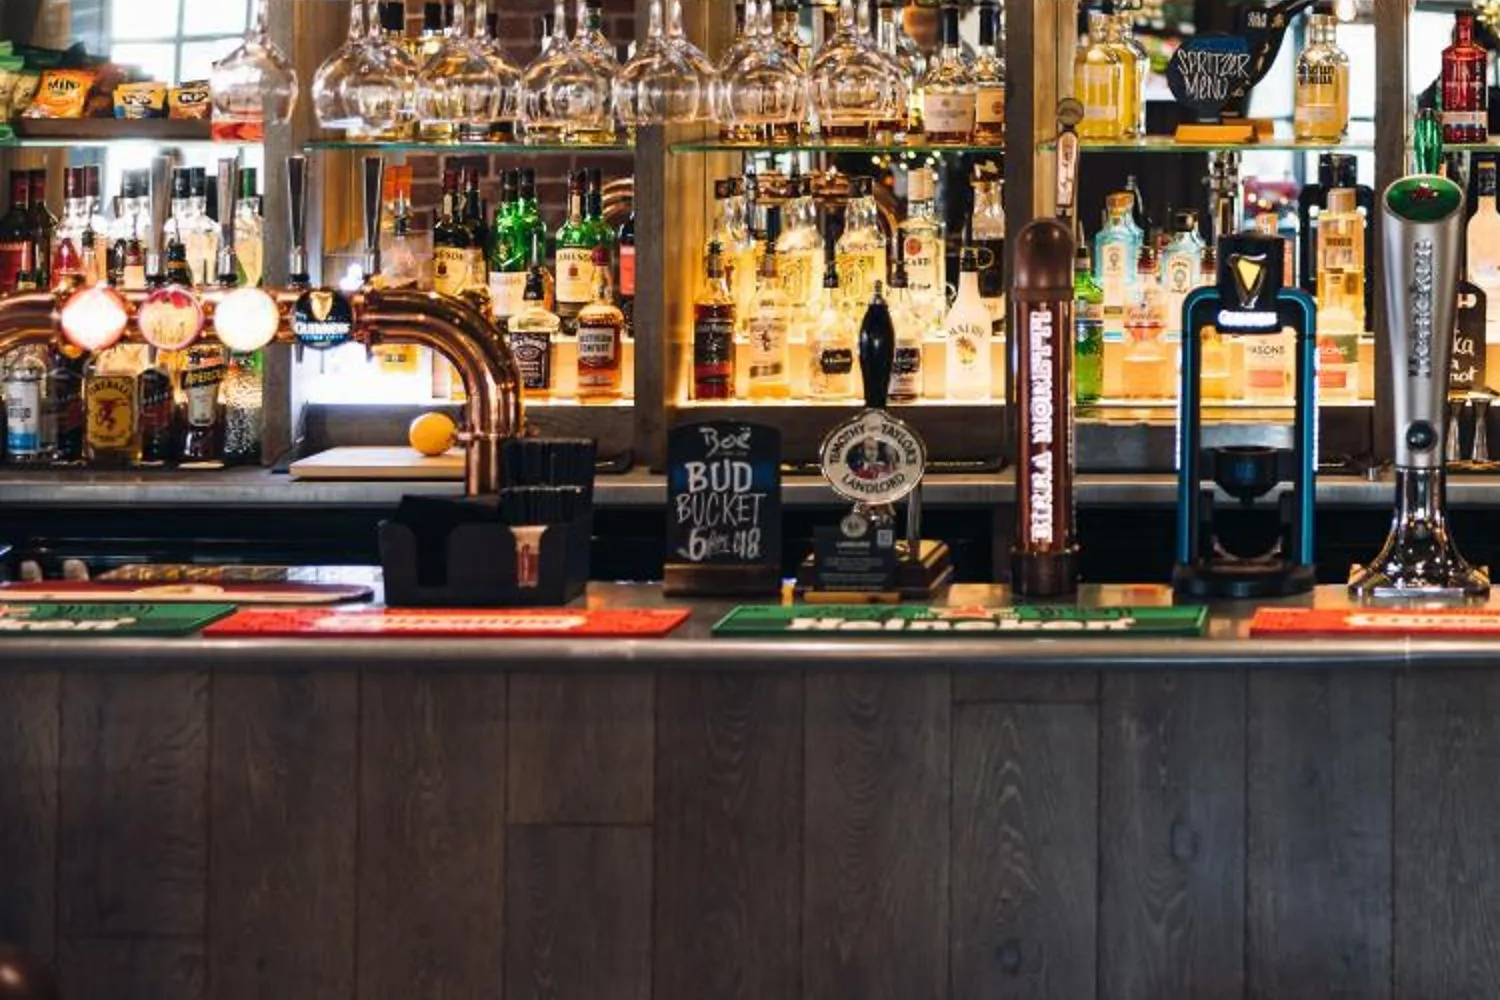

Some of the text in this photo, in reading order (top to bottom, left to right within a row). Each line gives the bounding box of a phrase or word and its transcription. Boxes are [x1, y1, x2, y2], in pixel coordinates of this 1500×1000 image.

[829, 423, 865, 464] TIMOTHY
[685, 458, 753, 493] BUD
[842, 473, 905, 493] LANDLORD
[676, 492, 768, 527] BUCKET
[787, 617, 1136, 631] Heineken
